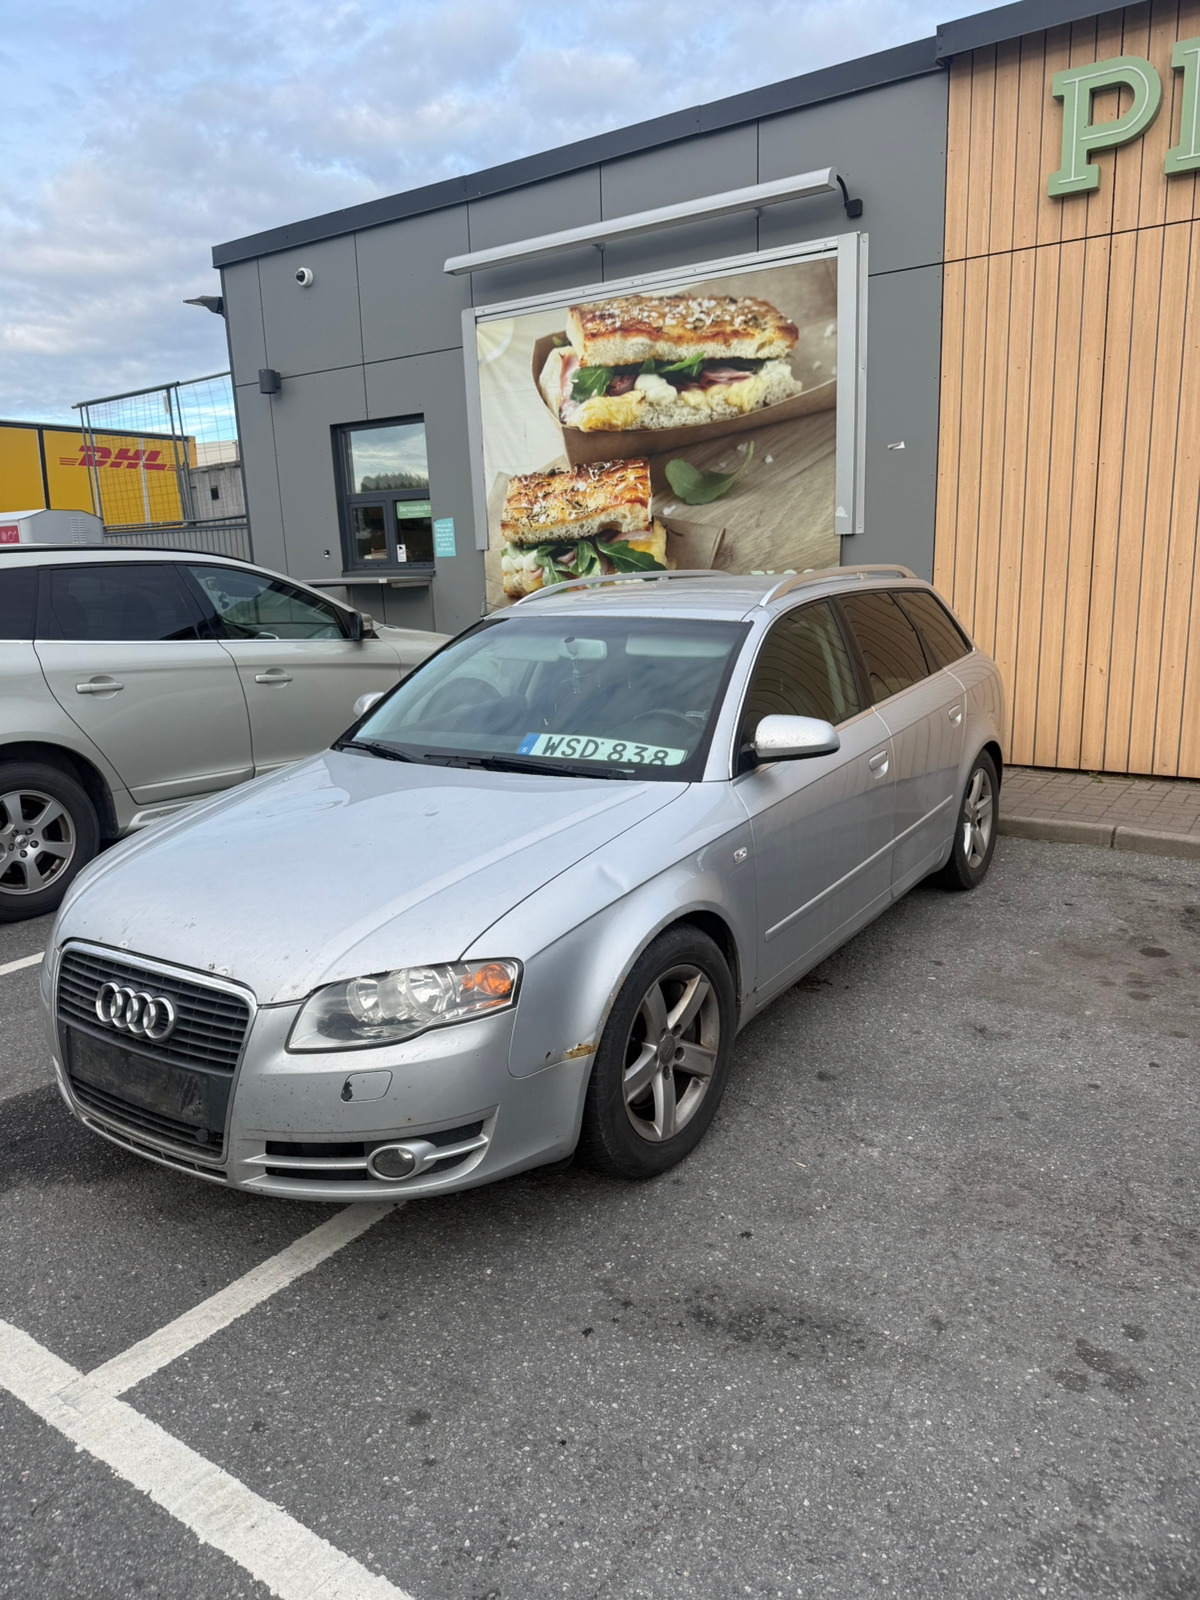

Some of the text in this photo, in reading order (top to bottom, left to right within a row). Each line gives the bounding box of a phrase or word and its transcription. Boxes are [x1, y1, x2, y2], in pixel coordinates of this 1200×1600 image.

[78, 445, 167, 471] DHL
[542, 736, 669, 766] WSD 838
